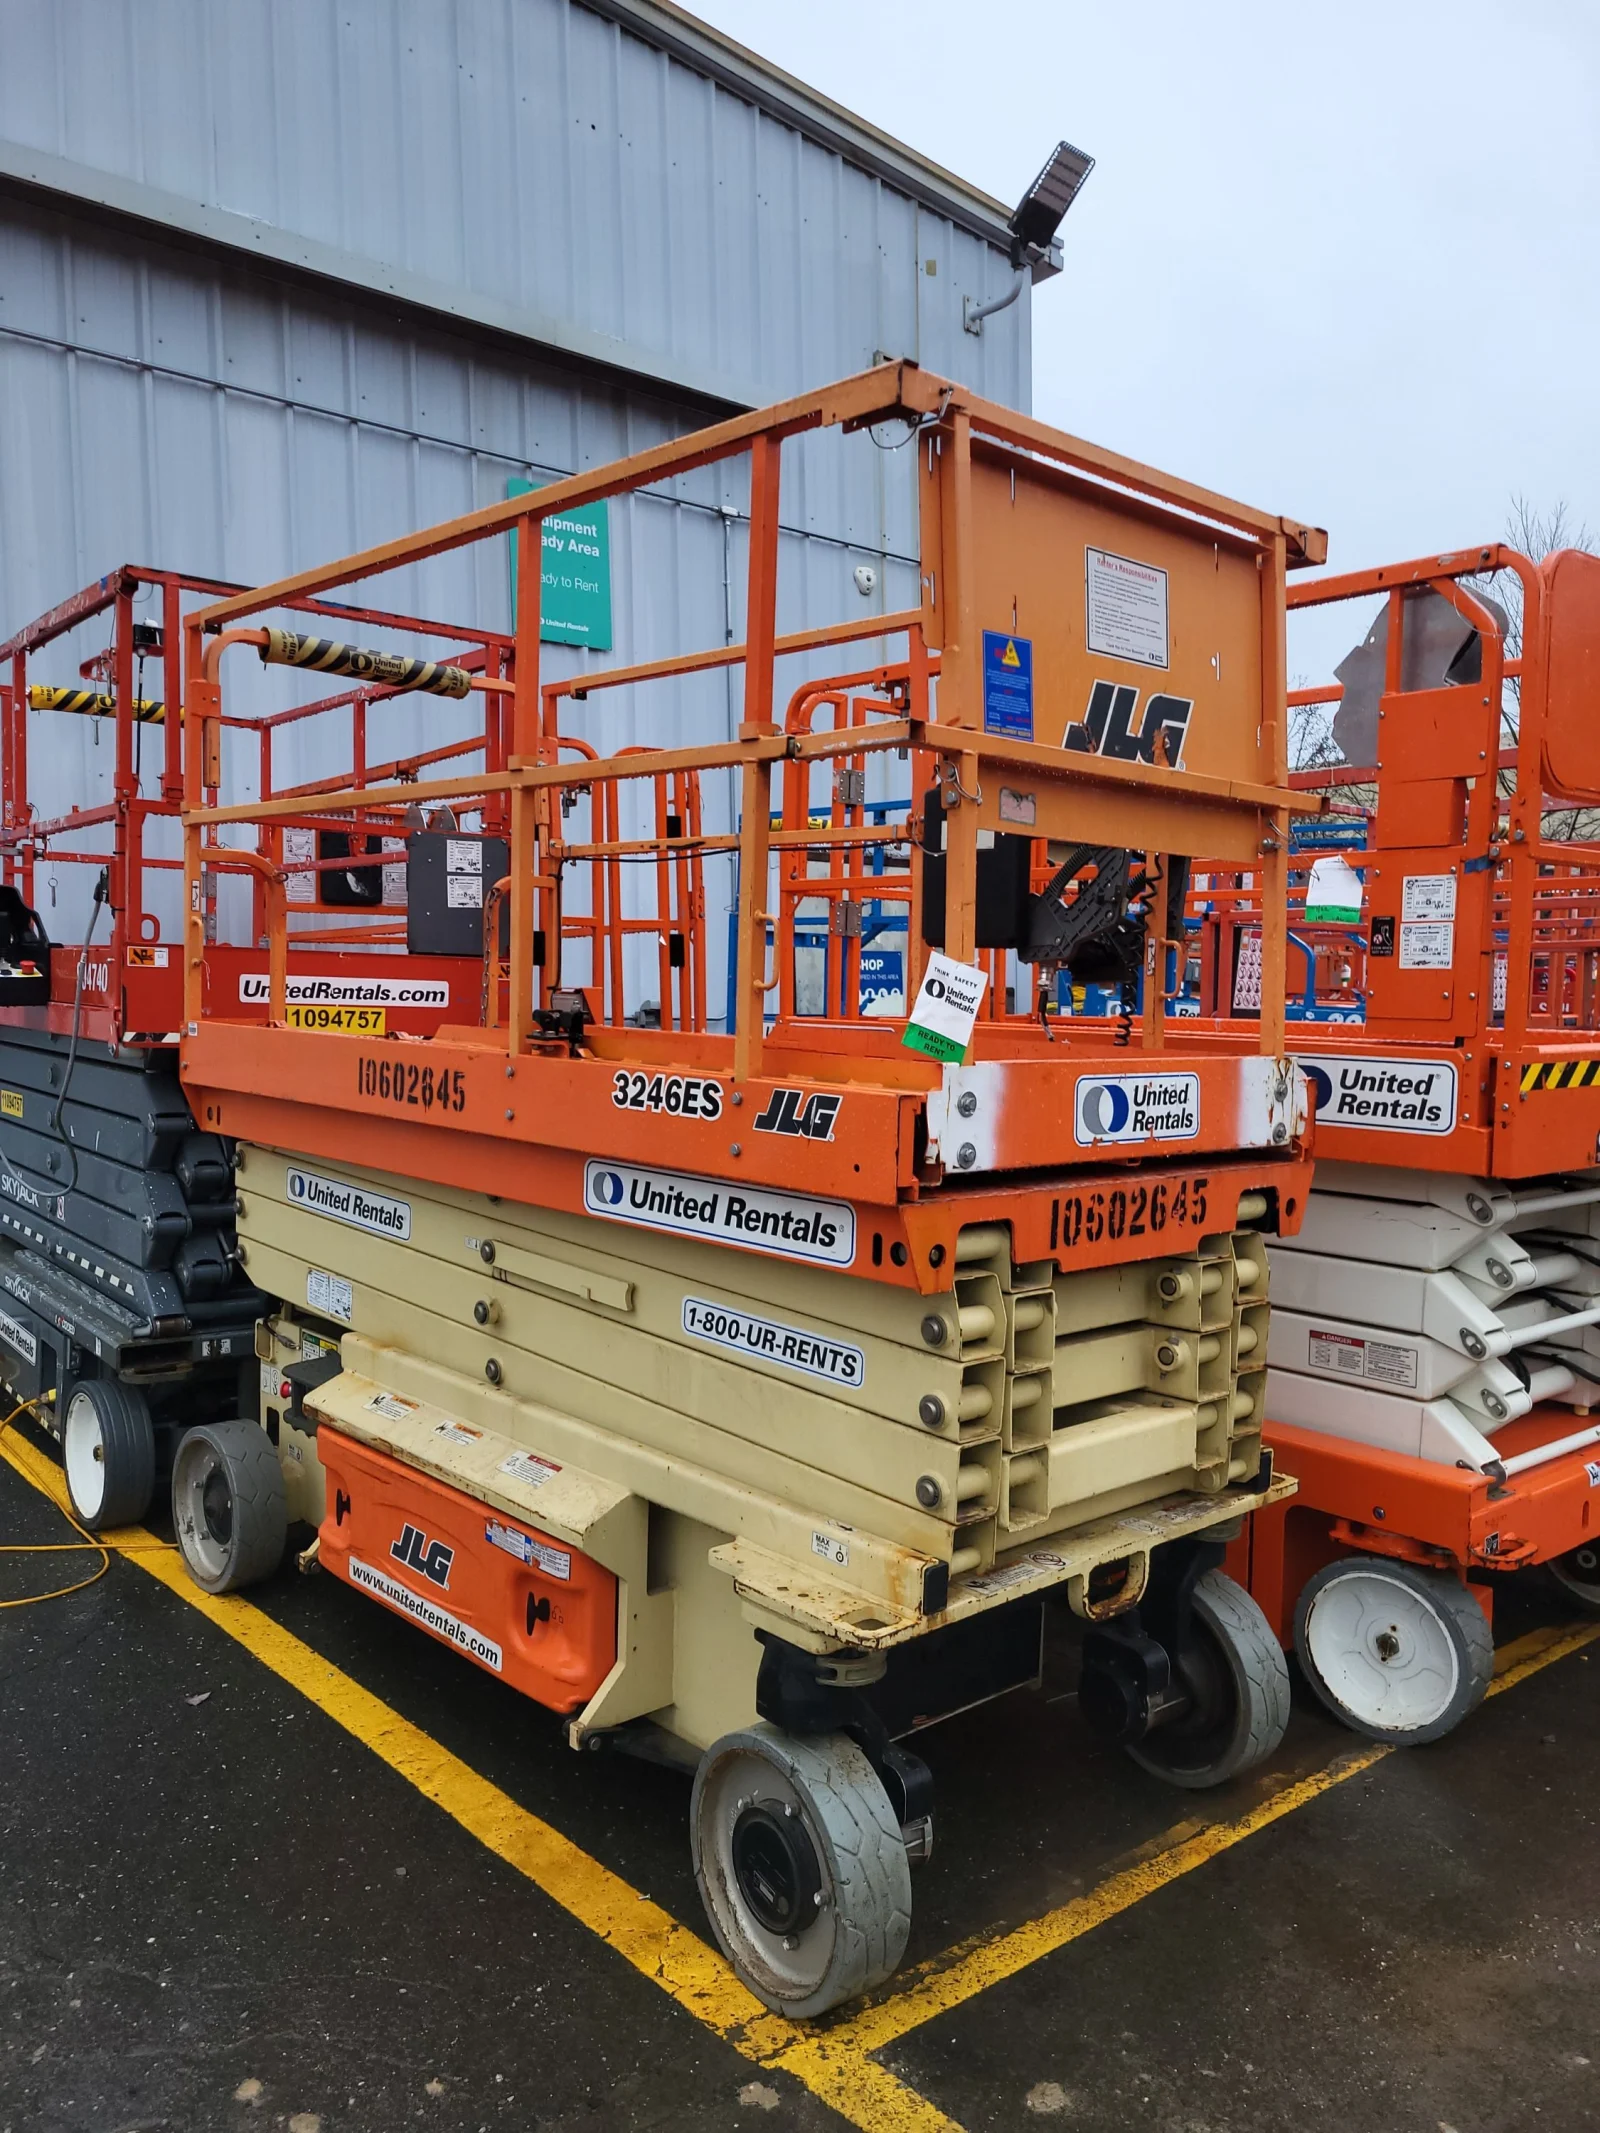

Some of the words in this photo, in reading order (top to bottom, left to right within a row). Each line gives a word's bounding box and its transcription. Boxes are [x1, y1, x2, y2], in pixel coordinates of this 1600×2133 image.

[541, 515, 598, 538] uipment
[541, 535, 564, 552] ady
[568, 539, 600, 557] Area
[540, 572, 559, 588] ady
[561, 576, 572, 588] to
[574, 577, 599, 593] Rent
[546, 618, 566, 629] United
[567, 622, 589, 632] Rentals
[373, 666, 404, 678] Rentals
[374, 657, 402, 670] United
[1062, 679, 1195, 768] JLG
[861, 958, 884, 971] HOP
[934, 967, 949, 977] THINK
[954, 976, 978, 988] SAFETY
[243, 979, 446, 1003] UnedRentals.com
[947, 986, 976, 1004] United
[945, 995, 975, 1015] Rentals
[917, 1030, 944, 1045] READY
[946, 1043, 956, 1051] TO
[923, 1044, 945, 1057] RENT
[1339, 1069, 1434, 1096] United
[612, 1072, 722, 1118] 3246ES
[1133, 1084, 1188, 1107] United
[753, 1088, 843, 1140] JLG
[1132, 1107, 1194, 1132] Rentals
[1337, 1097, 1442, 1122] Rentals
[1, 1171, 40, 1207] SKYJACK
[307, 1180, 350, 1213] United
[353, 1195, 404, 1231] Rentals
[629, 1179, 720, 1224] United
[724, 1193, 838, 1248] Rentals
[1050, 1178, 1208, 1250] 10602645
[0, 1315, 16, 1342] United
[15, 1329, 34, 1358] Rentals
[688, 1307, 858, 1379] 1-800-UR-RENTS
[1326, 1334, 1352, 1345] DANGER
[815, 1534, 830, 1548] MAX
[389, 1522, 455, 1590] JLG
[352, 1564, 499, 1666] www.unitedrentals.com
